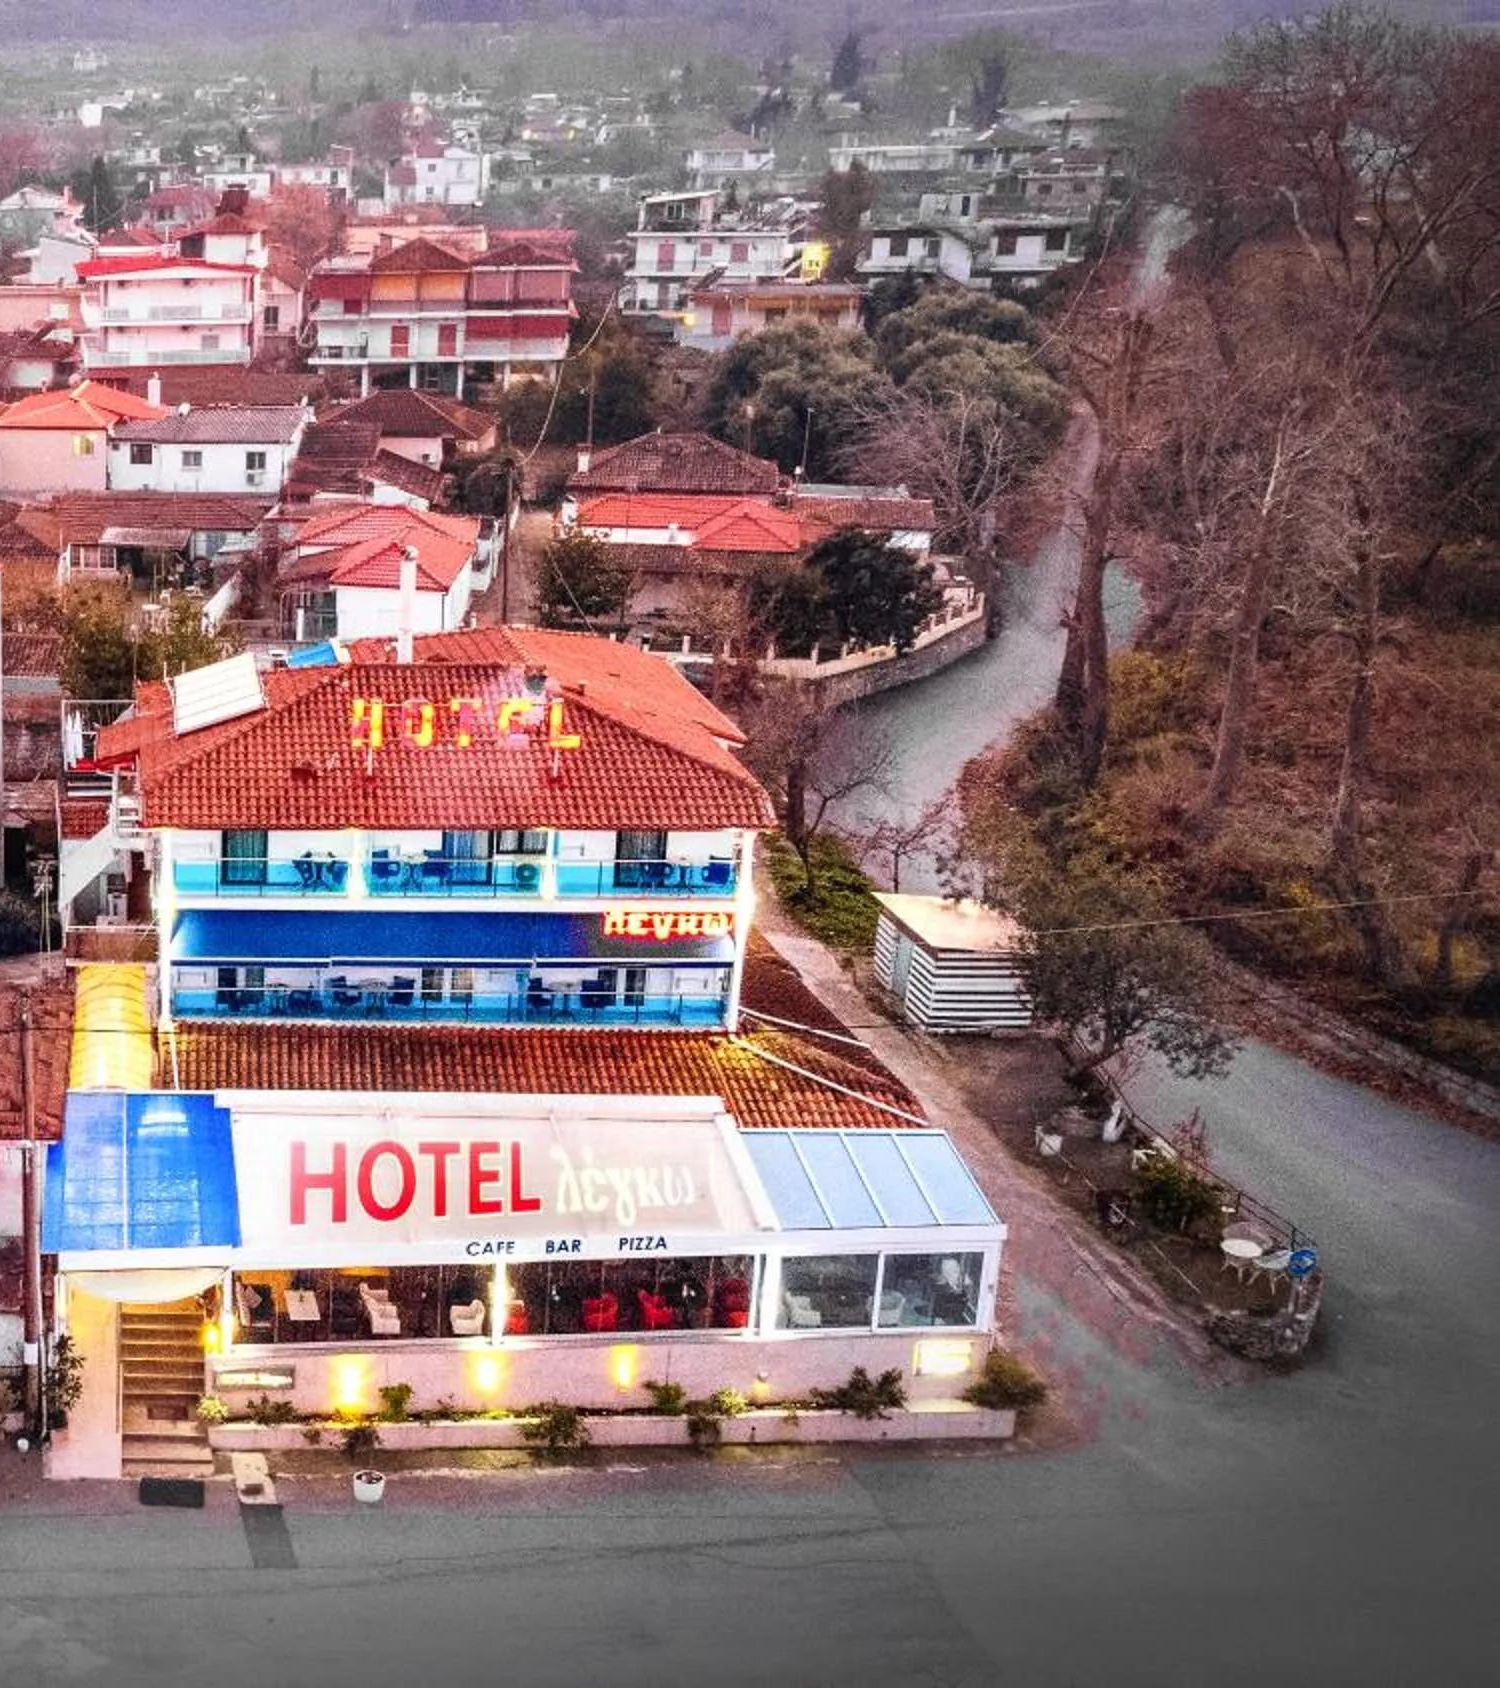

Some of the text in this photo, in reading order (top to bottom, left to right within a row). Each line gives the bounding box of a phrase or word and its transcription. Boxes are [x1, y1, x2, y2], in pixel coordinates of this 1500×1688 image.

[350, 698, 581, 749] HOTEL
[289, 1139, 542, 1225] HOTEL
[549, 1144, 696, 1227] λέγκω
[465, 1235, 668, 1256] CAFE BAR PIZZA
